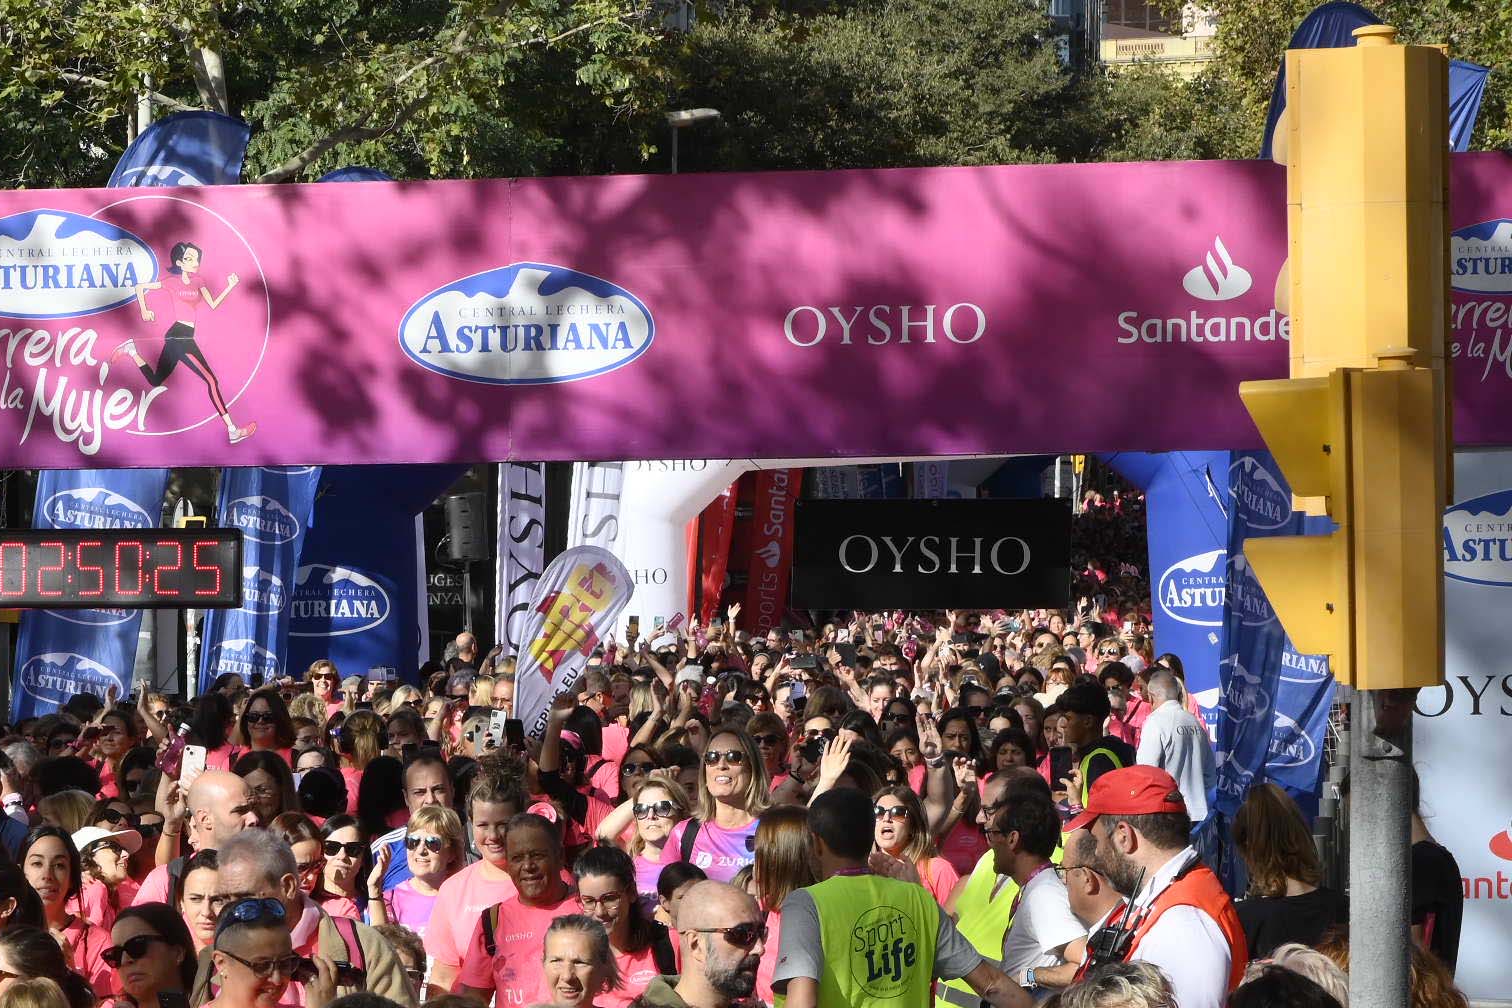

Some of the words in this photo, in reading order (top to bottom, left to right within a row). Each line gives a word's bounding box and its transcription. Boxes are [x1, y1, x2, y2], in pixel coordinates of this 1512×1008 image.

[61, 246, 134, 257] LECHERA
[458, 305, 538, 319] CENTRAL
[544, 303, 626, 316] LECHERA
[783, 302, 986, 347] OYSHO
[1117, 309, 1290, 344] Santande
[419, 309, 634, 354] ASTURIANA
[1467, 330, 1485, 358] la
[0, 370, 25, 409] la
[19, 363, 169, 456] Mujer
[0, 541, 221, 596] 02:50:25
[838, 534, 1032, 576] OYSHO
[1181, 576, 1225, 586] CENTRA
[289, 598, 381, 619] TURIANA
[25, 668, 118, 699] ASTURIAN
[854, 913, 905, 953] Sport
[864, 936, 917, 983] Life
[505, 988, 524, 1005] TU
